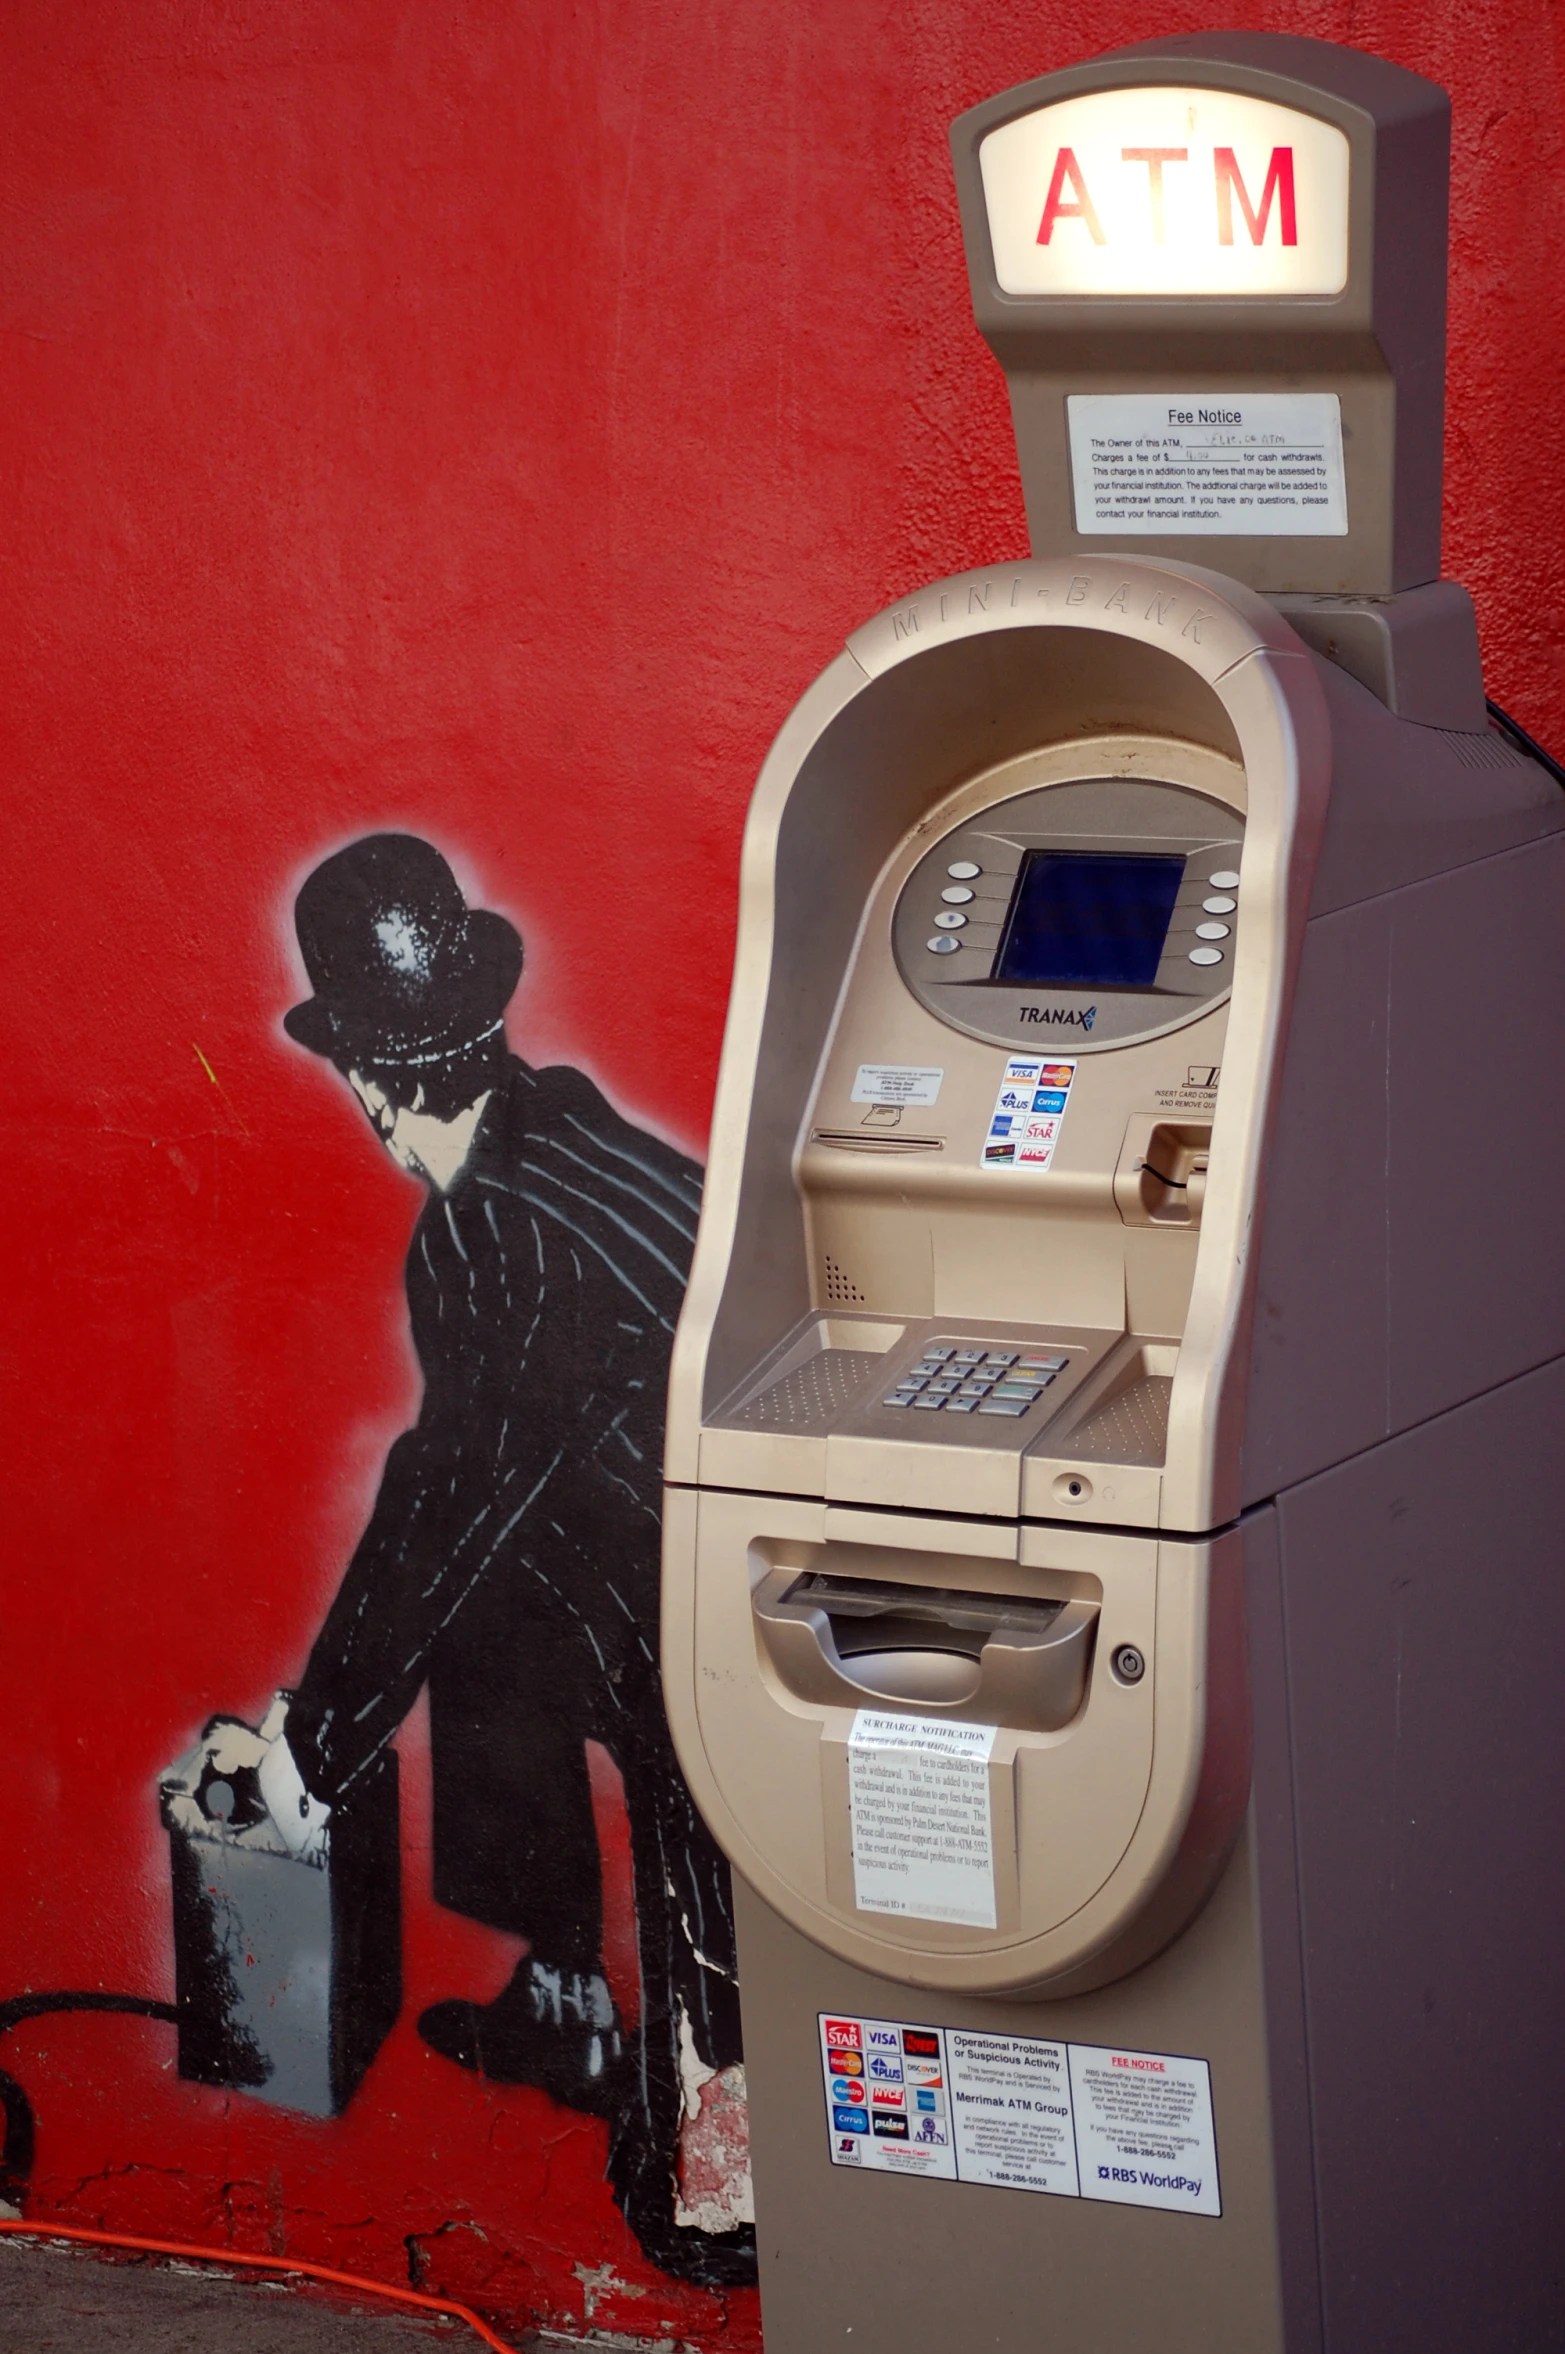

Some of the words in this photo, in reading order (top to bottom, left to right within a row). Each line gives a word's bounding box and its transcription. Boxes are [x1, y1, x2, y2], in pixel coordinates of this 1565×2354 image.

[1035, 147, 1298, 246] ATM
[1168, 409, 1194, 423] Fee
[1198, 409, 1242, 423] Notice
[1091, 439, 1105, 448] The
[1108, 439, 1132, 448] Owner
[1136, 439, 1143, 448] of
[1146, 439, 1160, 448] this
[1091, 453, 1124, 463] Charges
[1136, 453, 1149, 462] fee
[1152, 453, 1160, 462] of
[1164, 452, 1169, 462] $
[1244, 453, 1254, 462] for
[1258, 453, 1277, 462] cash
[1093, 467, 1108, 476] This
[1110, 467, 1136, 477] charge
[1138, 467, 1144, 476] is
[1146, 467, 1153, 476] in
[1155, 467, 1186, 476] addition
[1187, 467, 1195, 476] to
[1197, 469, 1210, 477] any
[1212, 467, 1229, 476] fees
[1231, 467, 1245, 476] that
[1248, 469, 1264, 477] may
[1266, 467, 1276, 476] be
[1278, 467, 1315, 476] assessed
[1317, 467, 1326, 477] by
[1112, 482, 1143, 490] financial
[1145, 482, 1184, 490] institution.
[1186, 482, 1200, 490] The
[1240, 482, 1266, 491] charge
[1268, 482, 1279, 490] will
[1281, 482, 1291, 490] be
[1293, 482, 1318, 490] added
[1320, 482, 1327, 490] to
[1095, 498, 1111, 506] your
[1154, 496, 1186, 504] amount.
[1191, 496, 1196, 504] If
[1200, 498, 1214, 506] you
[1217, 496, 1236, 504] have
[1240, 498, 1253, 506] any
[1257, 496, 1298, 506] questions,
[1302, 496, 1328, 506] please
[1096, 510, 1125, 518] contact
[1128, 512, 1144, 520] your
[1147, 510, 1179, 518] financial
[1182, 510, 1222, 518] institution.
[892, 575, 1217, 645] MINI-BANK
[1019, 1006, 1096, 1031] TRANAX
[1012, 1070, 1033, 1078] VISA
[1006, 1100, 1029, 1109] PLUS
[1037, 1098, 1060, 1106] Cirrus
[1026, 1128, 1053, 1138] STAR
[1023, 1148, 1048, 1157] NYCE
[862, 1718, 918, 1732] SURCHARGE
[921, 1725, 986, 1741] NOTIFICATION
[908, 1770, 922, 1781] This
[924, 1773, 933, 1784] fee
[936, 1775, 940, 1784] is
[943, 1775, 960, 1787] added
[962, 1779, 969, 1788] to
[971, 1782, 985, 1792] your
[856, 1810, 870, 1820] ATM
[877, 1814, 903, 1826] sponsored
[904, 1816, 911, 1829] by
[912, 1817, 927, 1829] Palm
[927, 1819, 945, 1831] Desert
[946, 1822, 969, 1835] National
[856, 1824, 873, 1836] Please
[874, 1827, 884, 1837] call
[885, 1830, 910, 1842] customer
[912, 1835, 932, 1847] support
[933, 1837, 939, 1845] at
[860, 1896, 889, 1908] Terminal
[891, 1900, 899, 1908] ID
[828, 2031, 858, 2046] STAR
[868, 2032, 897, 2046] VISA
[954, 2036, 1010, 2051] Operational
[1012, 2043, 1059, 2057] Problems
[830, 2057, 862, 2067] MasterCard
[955, 2050, 964, 2058] or
[967, 2050, 1021, 2065] Suspicious
[1024, 2057, 1060, 2072] Activity
[1112, 2056, 1129, 2066] FEE
[1132, 2059, 1165, 2071] NOTICE
[879, 2068, 900, 2079] PLUS
[908, 2064, 938, 2073] DISCOVER
[981, 2068, 1005, 2077] terminal
[1013, 2072, 1042, 2082] Operated
[958, 2073, 972, 2081] RBS
[974, 2075, 1003, 2086] WorldPay
[1025, 2081, 1051, 2091] Serviced
[1052, 2085, 1060, 2093] by
[836, 2087, 862, 2096] Maestro
[874, 2087, 904, 2100] NYCE
[956, 2092, 1004, 2107] Merrimak
[1008, 2099, 1031, 2110] ATM
[1034, 2102, 1068, 2116] Group
[839, 2114, 863, 2124] Cirrus
[875, 2118, 905, 2130] pulse
[915, 2131, 944, 2143] AFFN
[1117, 2145, 1176, 2160] 1-888-286-5552
[989, 2171, 1047, 2186] 1-888-286-5552
[1112, 2168, 1137, 2183] RBS
[1139, 2171, 1202, 2196] WorldPay
